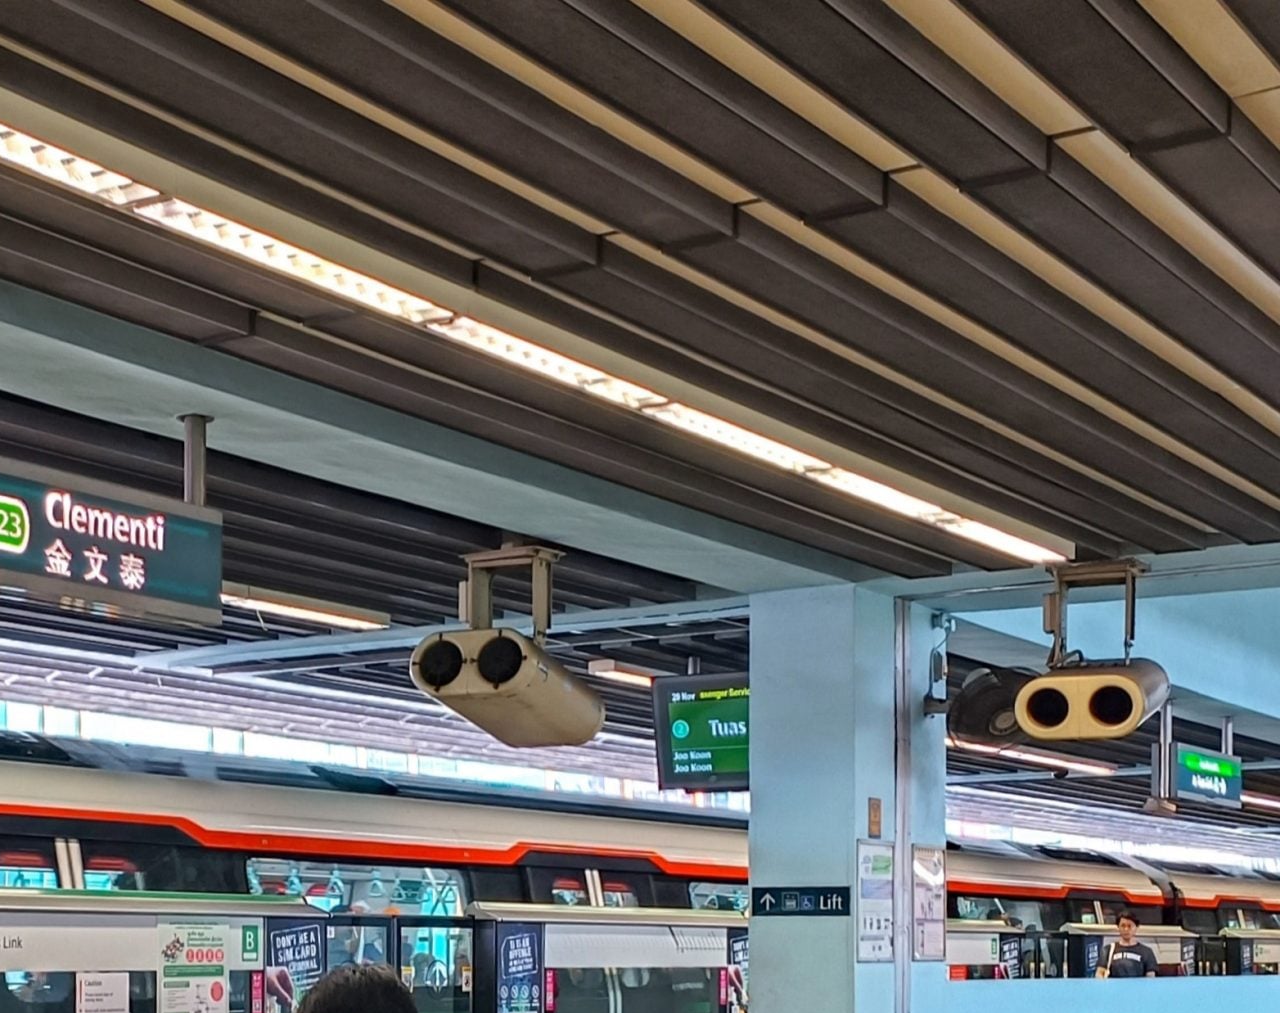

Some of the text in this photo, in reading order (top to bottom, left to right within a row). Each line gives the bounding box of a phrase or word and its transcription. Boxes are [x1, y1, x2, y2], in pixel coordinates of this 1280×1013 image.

[45, 491, 165, 551] Clementi
[44, 538, 146, 590] 金文泰
[708, 720, 747, 736] Tuas
[673, 751, 711, 761] Joo Koon
[674, 763, 712, 773] Joo Koon
[820, 893, 842, 910] Lift
[3, 935, 23, 949] Link
[246, 931, 254, 950] B
[276, 934, 297, 949] DON'T
[310, 931, 316, 943] A
[278, 944, 317, 963] SIM CARD
